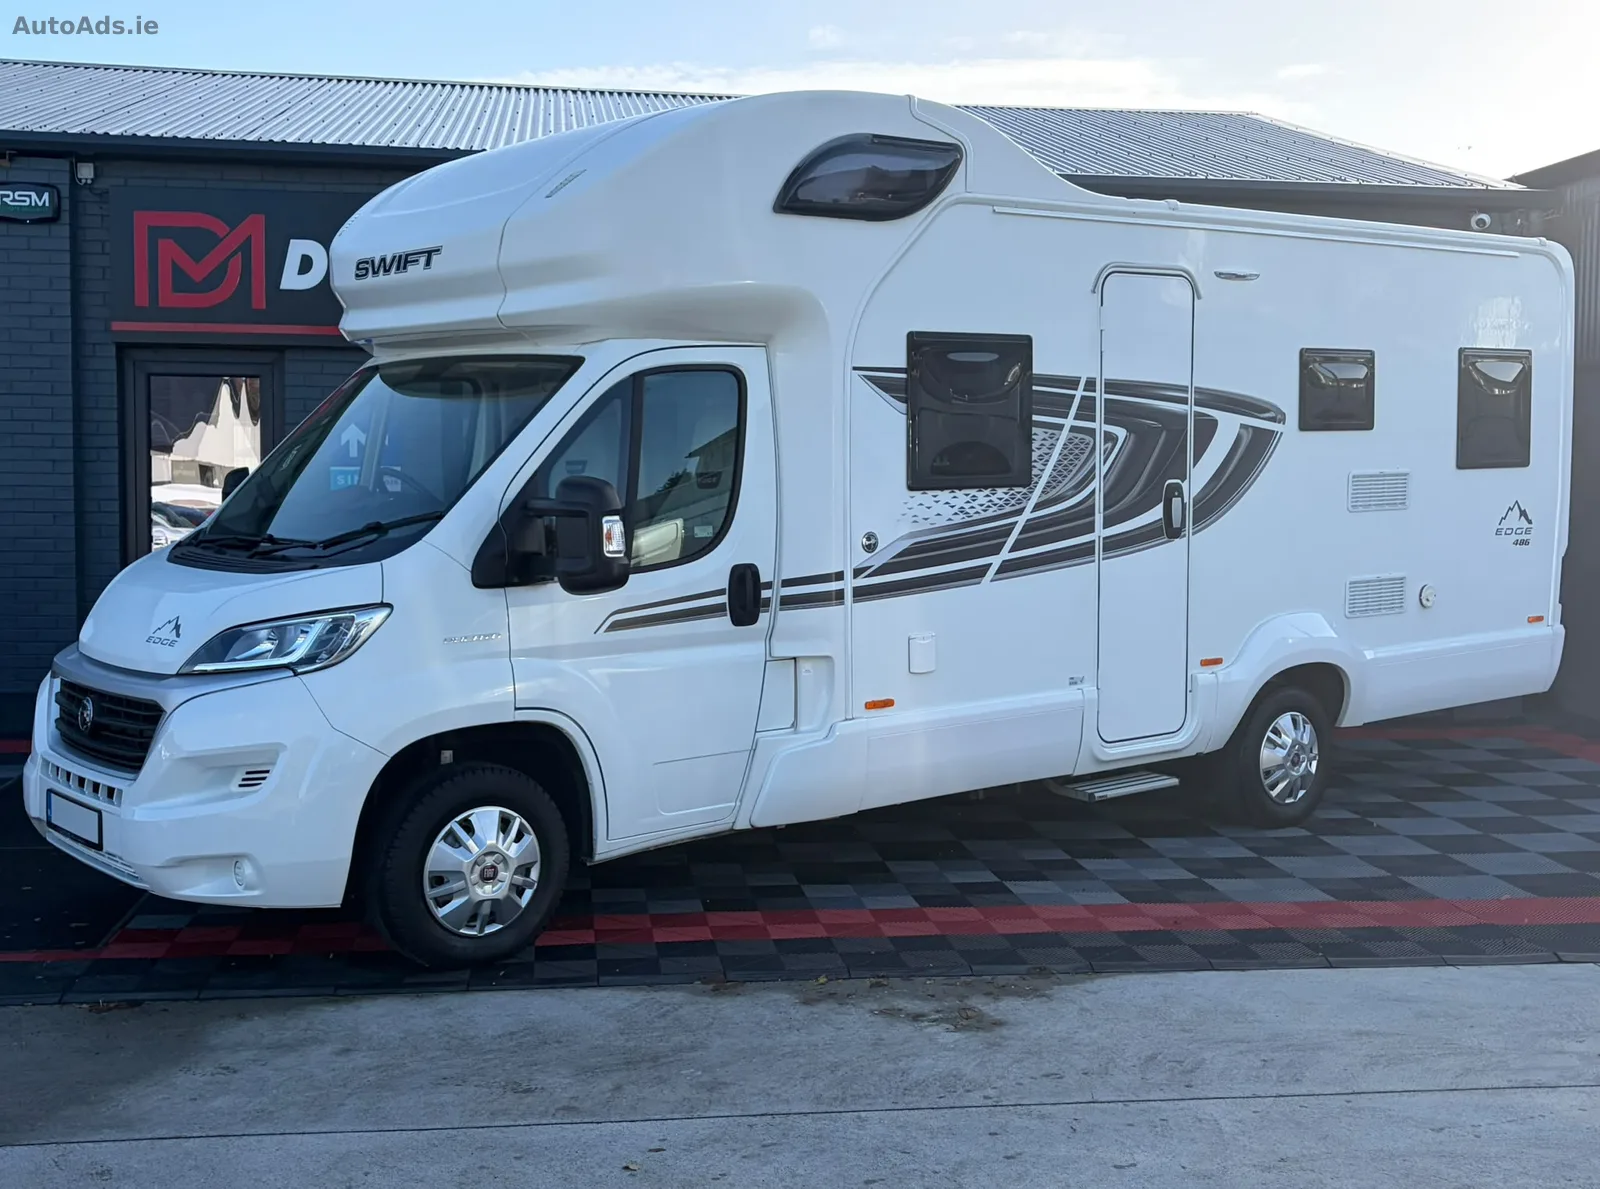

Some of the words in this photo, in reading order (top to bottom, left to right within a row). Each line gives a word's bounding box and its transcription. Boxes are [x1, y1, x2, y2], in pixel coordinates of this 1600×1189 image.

[0, 191, 49, 207] RSM
[354, 245, 443, 281] SWIFT
[1495, 527, 1533, 536] EDGE
[1512, 538, 1531, 546] 486
[145, 635, 178, 647] EDGE
